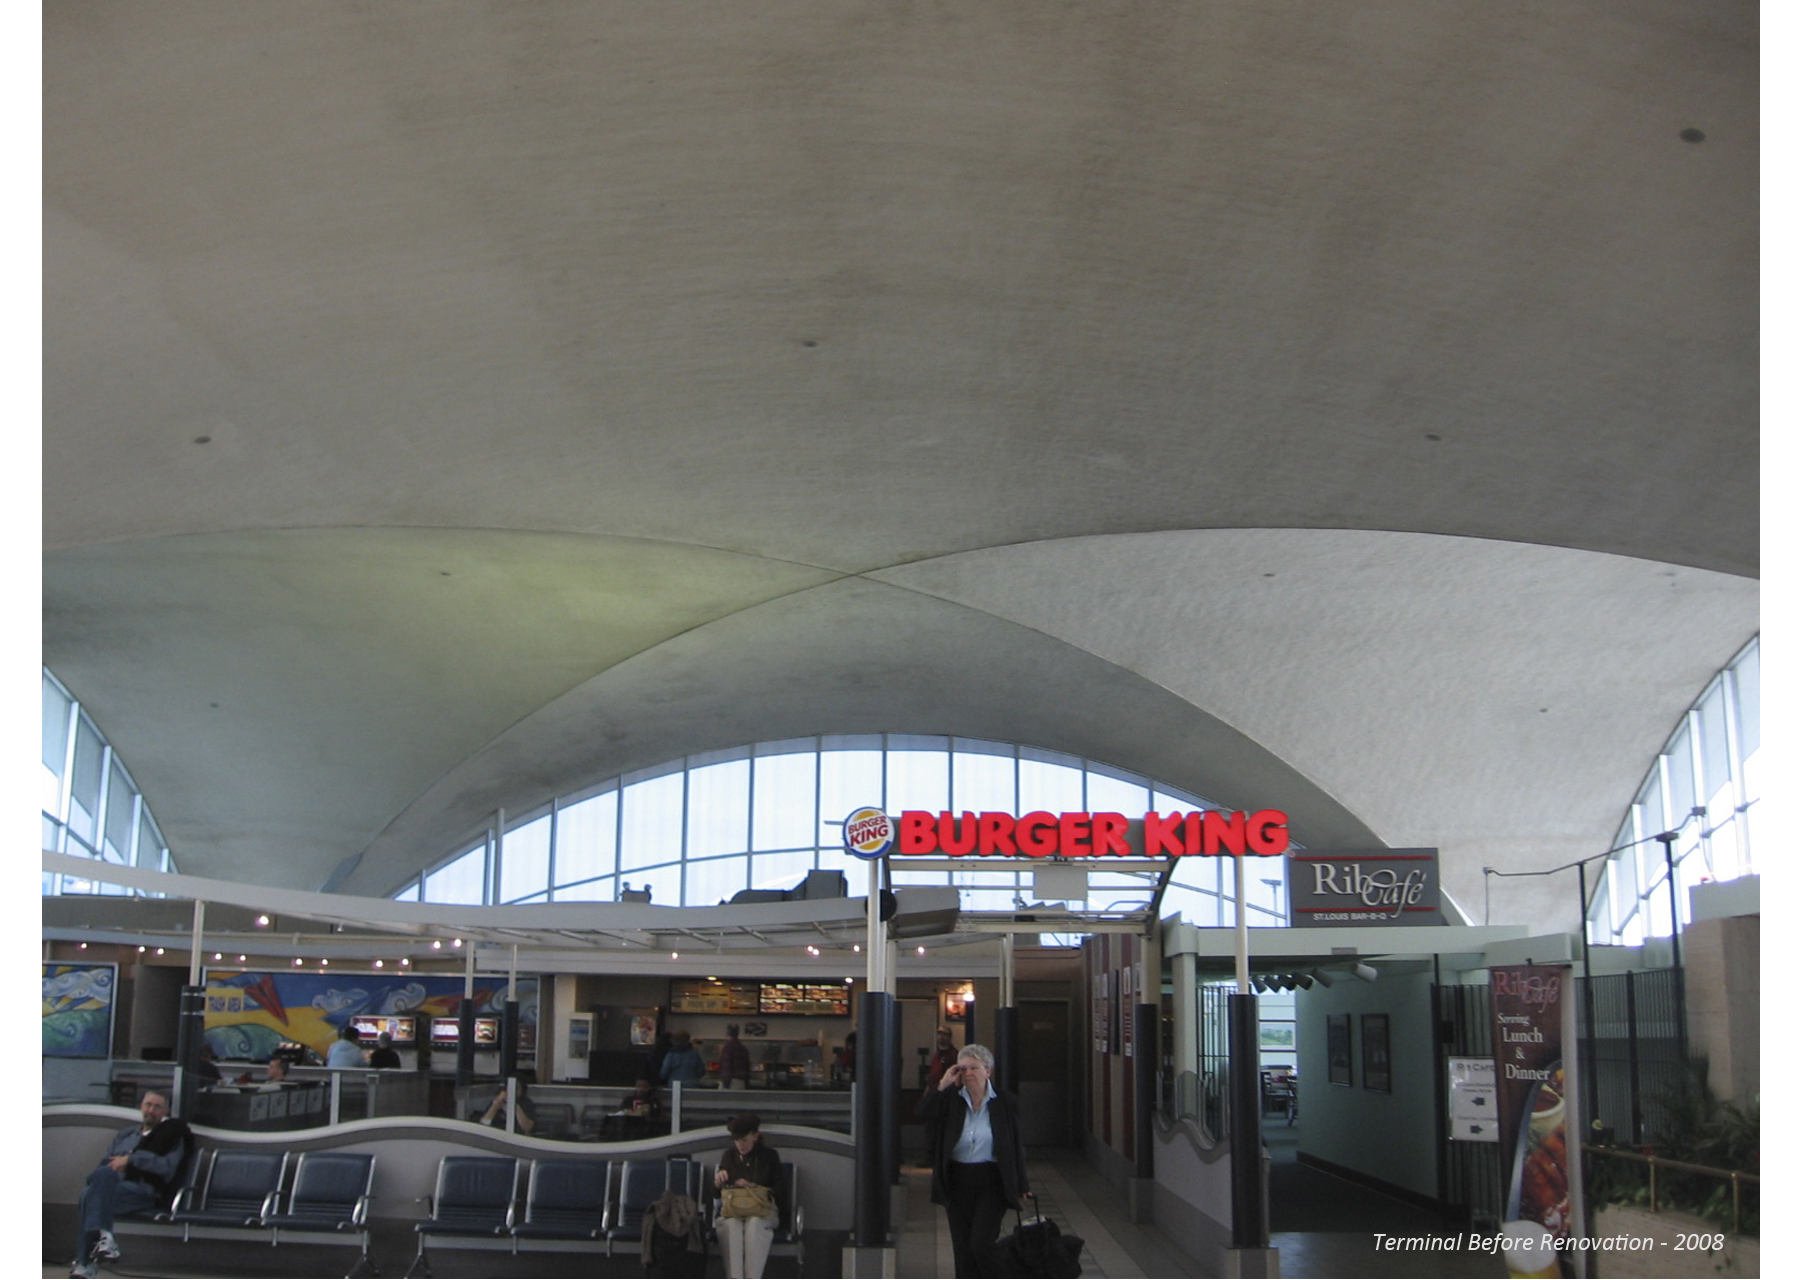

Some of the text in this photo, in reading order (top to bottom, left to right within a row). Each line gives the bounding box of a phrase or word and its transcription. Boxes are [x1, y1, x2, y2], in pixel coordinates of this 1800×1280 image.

[848, 815, 887, 834] BURGER
[900, 809, 1289, 857] BURGER KING
[849, 825, 889, 847] KING
[1311, 863, 1427, 918] Rib Café
[1350, 912, 1387, 920] BAR-B-Q
[1493, 971, 1528, 995] Rib
[1498, 1013, 1530, 1026] Serving
[1502, 1027, 1543, 1042] Lunch
[1515, 1046, 1525, 1059] &
[1505, 1063, 1551, 1080] Dinner
